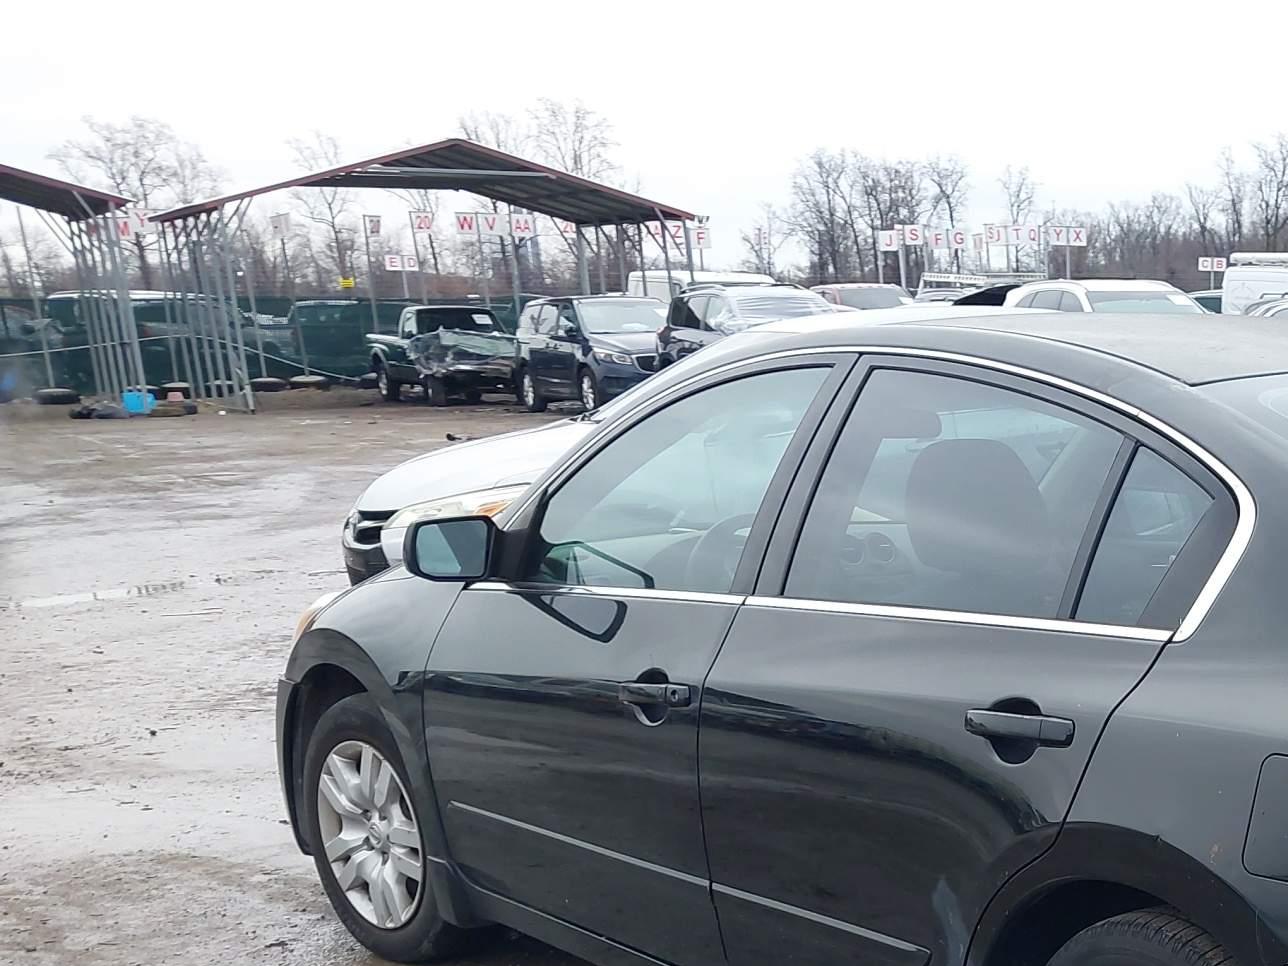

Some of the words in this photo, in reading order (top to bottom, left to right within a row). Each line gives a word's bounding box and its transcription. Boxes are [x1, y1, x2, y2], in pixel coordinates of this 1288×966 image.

[415, 215, 433, 230] 20
[457, 215, 473, 231] W
[484, 216, 496, 231] V
[514, 218, 532, 233] AA
[696, 231, 705, 246] F
[884, 234, 894, 247] J
[909, 228, 920, 241] S
[934, 232, 943, 246] F
[953, 231, 965, 245] G
[1011, 228, 1023, 241] T
[1053, 228, 1063, 241] Y
[1073, 228, 1083, 242] X
[388, 256, 399, 268] E
[407, 256, 417, 268] D
[1201, 259, 1210, 269] C
[1215, 259, 1224, 269] B
